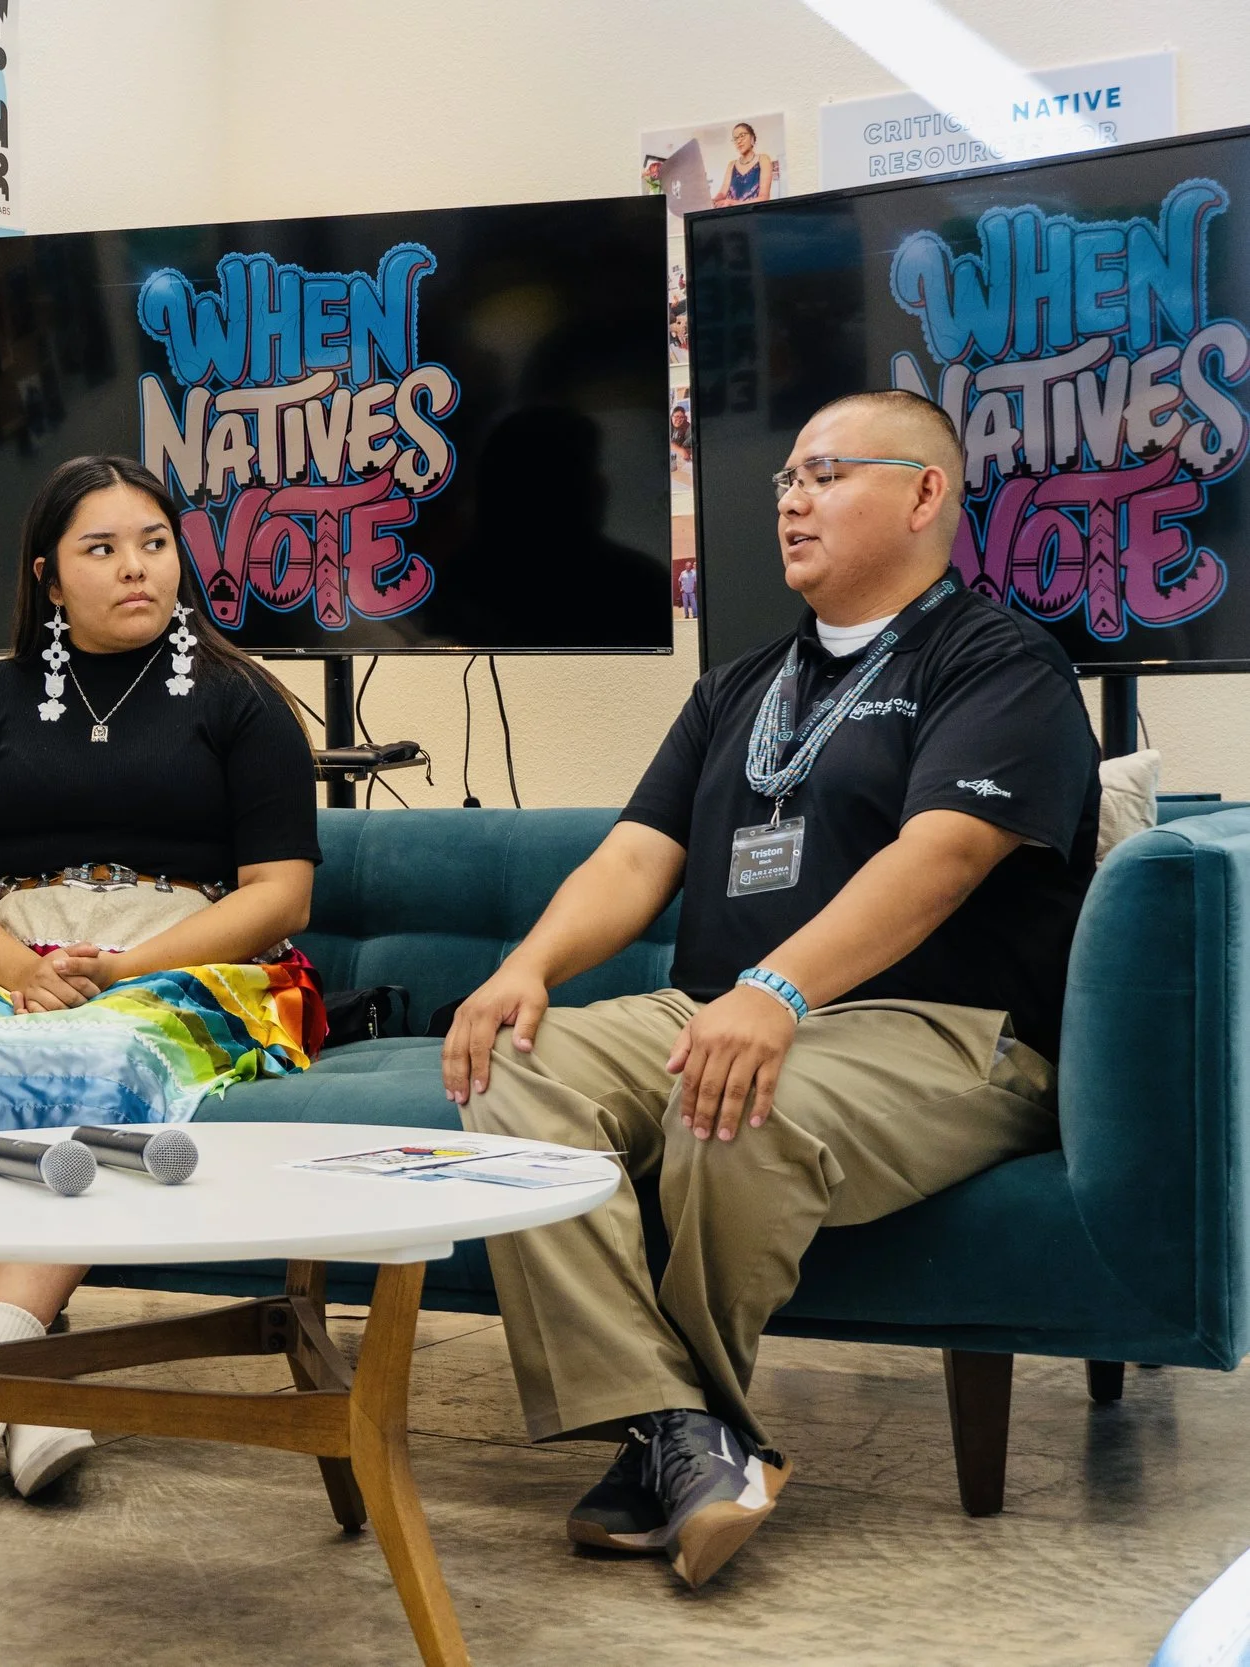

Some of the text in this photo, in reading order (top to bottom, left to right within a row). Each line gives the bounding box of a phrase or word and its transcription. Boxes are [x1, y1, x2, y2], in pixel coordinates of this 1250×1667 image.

[864, 86, 1122, 145] CRITIC NATIVE
[137, 242, 437, 386] WHEN
[890, 178, 1230, 364] WHEN
[139, 363, 458, 504] NATIVES
[179, 471, 435, 630] VOTE
[750, 847, 783, 860] Triston
[751, 865, 790, 877] ARIZONA
